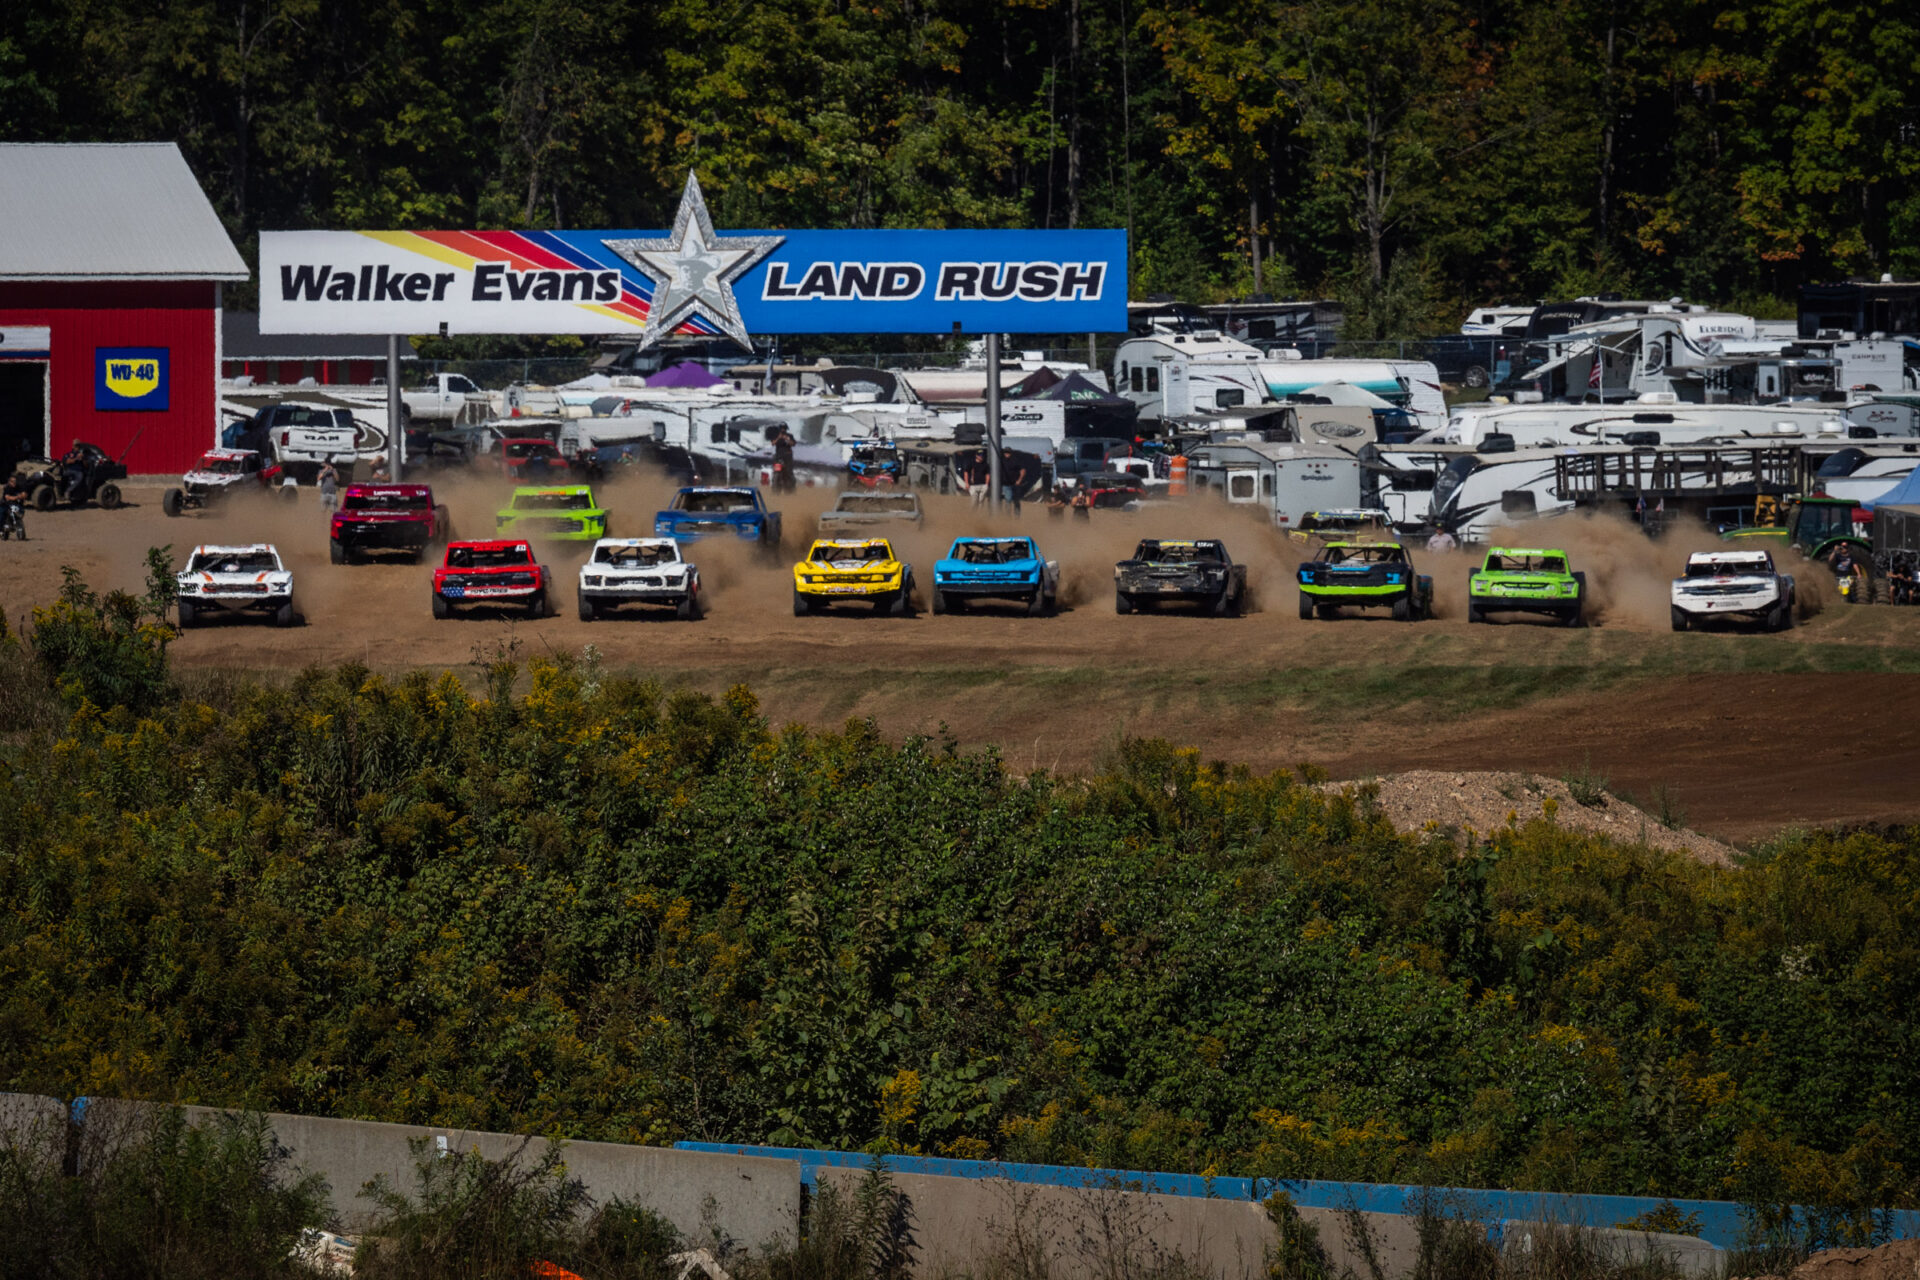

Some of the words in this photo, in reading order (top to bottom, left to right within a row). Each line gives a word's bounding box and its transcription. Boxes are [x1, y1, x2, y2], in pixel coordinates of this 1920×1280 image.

[280, 265, 455, 302] Walker
[472, 264, 620, 302] Evans
[764, 264, 923, 299] LAND
[937, 263, 1105, 299] RUSH
[1699, 325, 1744, 334] ELKRIDGE
[110, 363, 155, 381] WD-40
